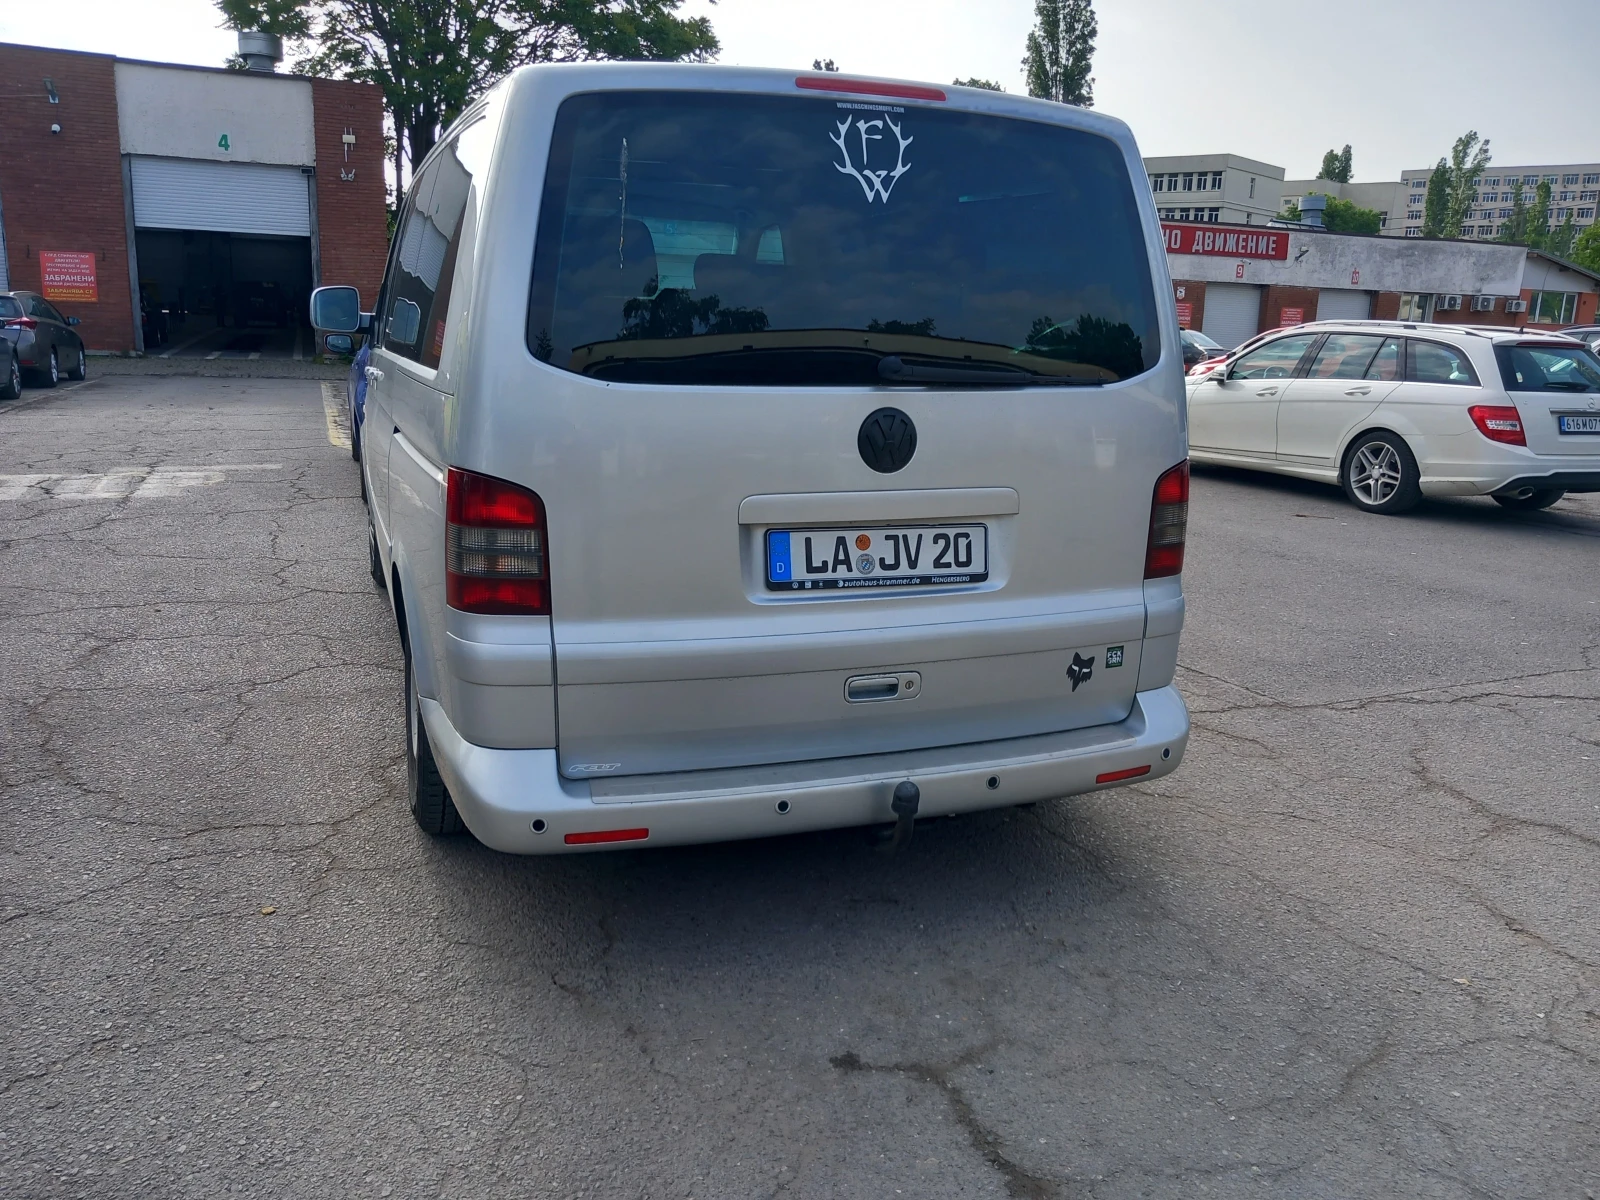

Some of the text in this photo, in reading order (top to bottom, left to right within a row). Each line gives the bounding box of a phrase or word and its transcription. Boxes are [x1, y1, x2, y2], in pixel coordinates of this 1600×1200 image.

[218, 134, 230, 151] 4
[1192, 230, 1277, 255] ДВИЖЕНИЕ
[1236, 265, 1244, 277] 9
[44, 274, 95, 282] ЗАБРАНЕНИ
[1566, 418, 1600, 430] 616M07
[804, 532, 973, 574] LA JV 20
[776, 562, 785, 573] D
[844, 577, 921, 587] autohaus-krammer.de
